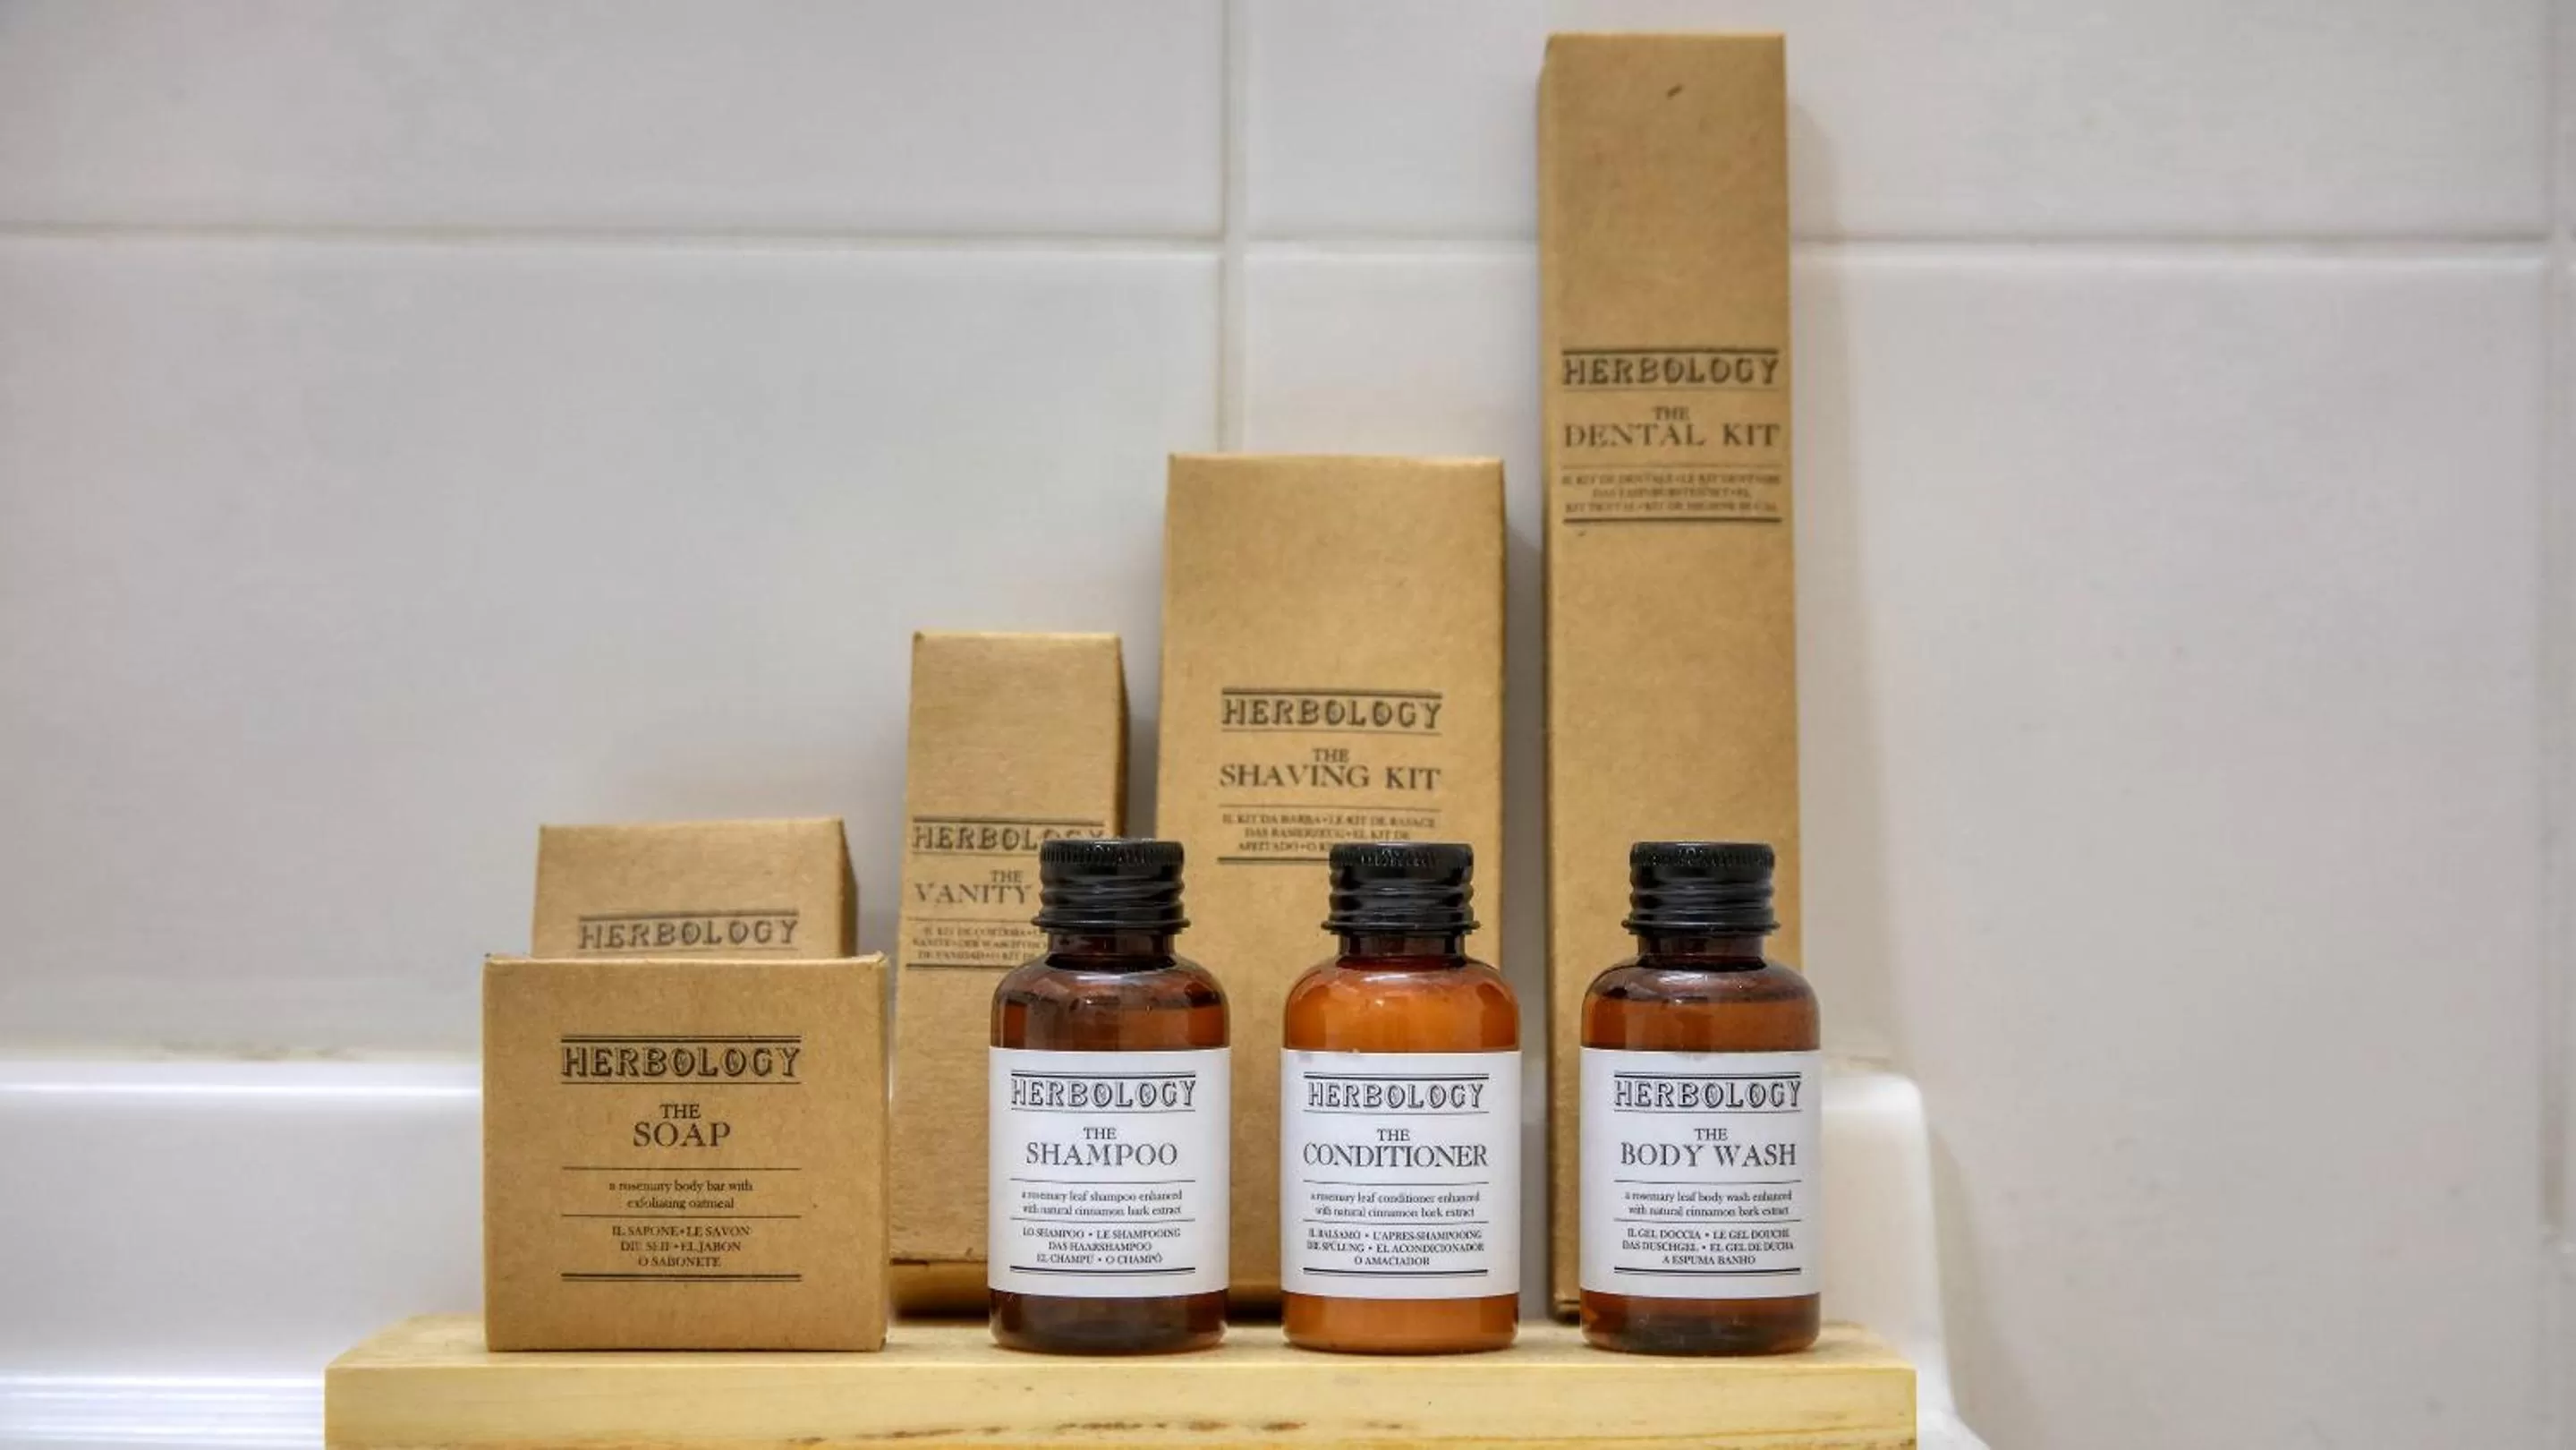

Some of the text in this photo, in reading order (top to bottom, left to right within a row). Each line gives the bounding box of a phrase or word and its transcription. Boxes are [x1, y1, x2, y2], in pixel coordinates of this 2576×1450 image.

[1562, 357, 1779, 386] HERBOLOGY
[1654, 405, 1690, 421] THE
[1564, 423, 1781, 448] DENTAL KIT
[1221, 698, 1442, 729] HERBOLOGY
[1312, 748, 1350, 763] THE
[1220, 763, 1442, 790] SHAVING KIT
[990, 869, 1024, 883] THE
[914, 883, 1033, 904] VANITY
[577, 919, 798, 950] HERBOLOGY
[561, 1046, 801, 1077] HERBOLOGY
[1011, 1078, 1195, 1107] HERBOLOGY
[1308, 1081, 1484, 1109] HERBOLOGY
[1614, 1080, 1801, 1108] HERBOLOGY
[659, 1104, 701, 1119] THE
[633, 1122, 731, 1147] SOAP
[1083, 1127, 1117, 1139] THE
[1377, 1129, 1411, 1141] THE
[1694, 1128, 1728, 1141] THE
[1026, 1142, 1177, 1166] SHAMPOO
[1303, 1142, 1488, 1167] CONDITIONER
[1620, 1142, 1797, 1167] BODY WASH
[619, 1181, 672, 1193] rosemary
[675, 1179, 704, 1193] body
[707, 1180, 725, 1191] bar
[727, 1178, 753, 1191] with
[688, 1197, 735, 1208] oatmeal
[1090, 1191, 1136, 1204] shampoo
[1357, 1192, 1377, 1203] leaf
[1378, 1193, 1435, 1204] conditioner
[1632, 1193, 1674, 1204] rosemary
[1678, 1191, 1697, 1202] leaf
[1700, 1191, 1723, 1204] body
[1727, 1192, 1749, 1202] wash
[1368, 1207, 1419, 1218] cinnamon
[1628, 1204, 1647, 1215] with
[1650, 1207, 1683, 1216] natural
[1686, 1207, 1736, 1217] cinnamon
[1739, 1207, 1759, 1216] bark
[705, 1225, 751, 1237] SAVON
[1036, 1228, 1084, 1239] SHAMPOO
[1096, 1230, 1112, 1239] LE
[1660, 1229, 1700, 1240] DOCCIA
[1713, 1230, 1728, 1240] LE
[1729, 1230, 1749, 1240] GEL
[1049, 1241, 1067, 1251] DAS
[1376, 1243, 1391, 1253] EL
[1622, 1241, 1640, 1250] DAS
[1710, 1242, 1725, 1251] EL
[1726, 1242, 1747, 1252] GEL
[651, 1256, 721, 1267] SABONETE
[1105, 1255, 1115, 1264] O
[1355, 1256, 1430, 1267] O AMACIADOR
[1672, 1256, 1714, 1266] ESPUMA
[1719, 1256, 1756, 1265] BANHO
